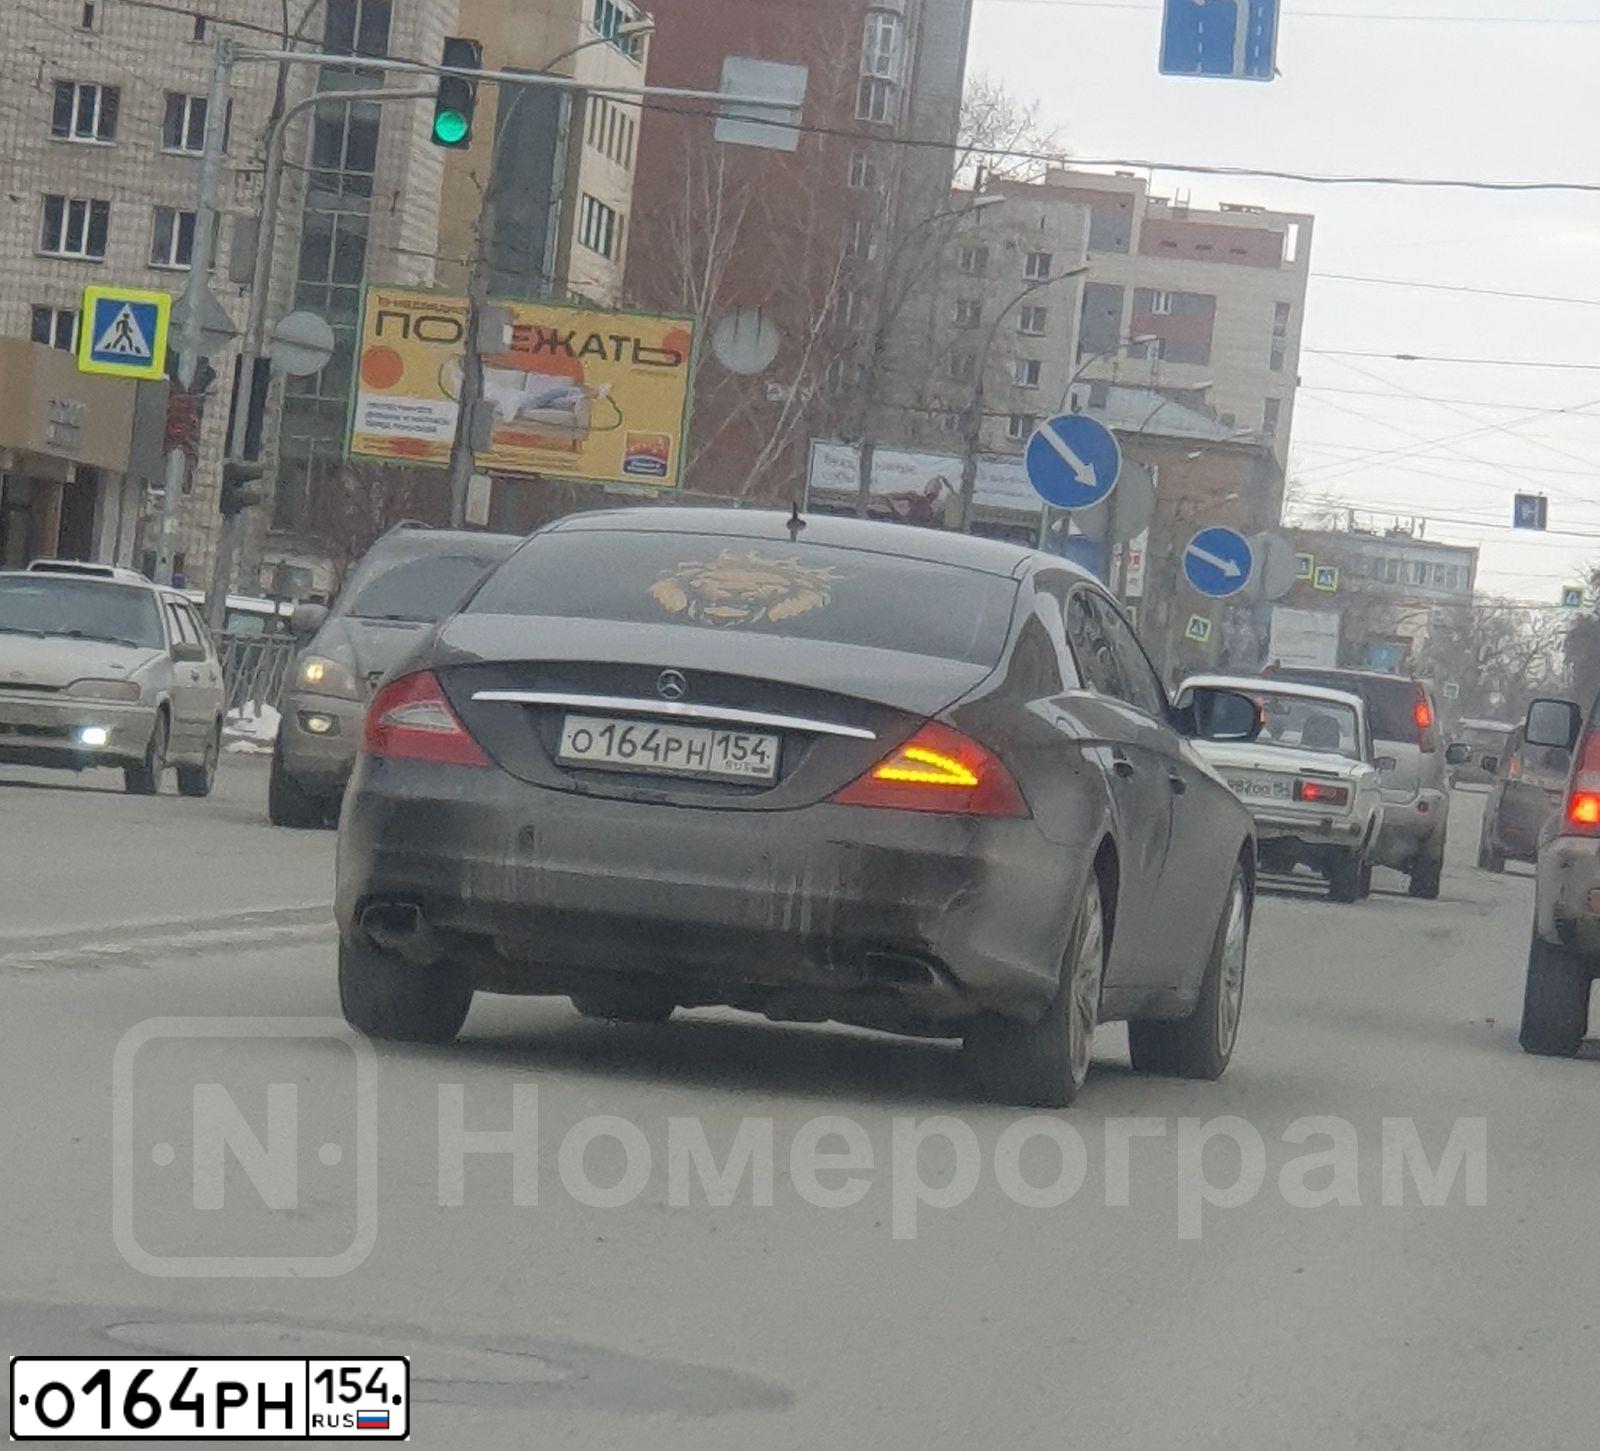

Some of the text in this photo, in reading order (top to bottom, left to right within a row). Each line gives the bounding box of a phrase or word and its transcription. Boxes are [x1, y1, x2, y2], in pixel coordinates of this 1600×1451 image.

[375, 311, 682, 367] ПОЕЖАТЬ
[571, 724, 767, 765] О164РН 154
